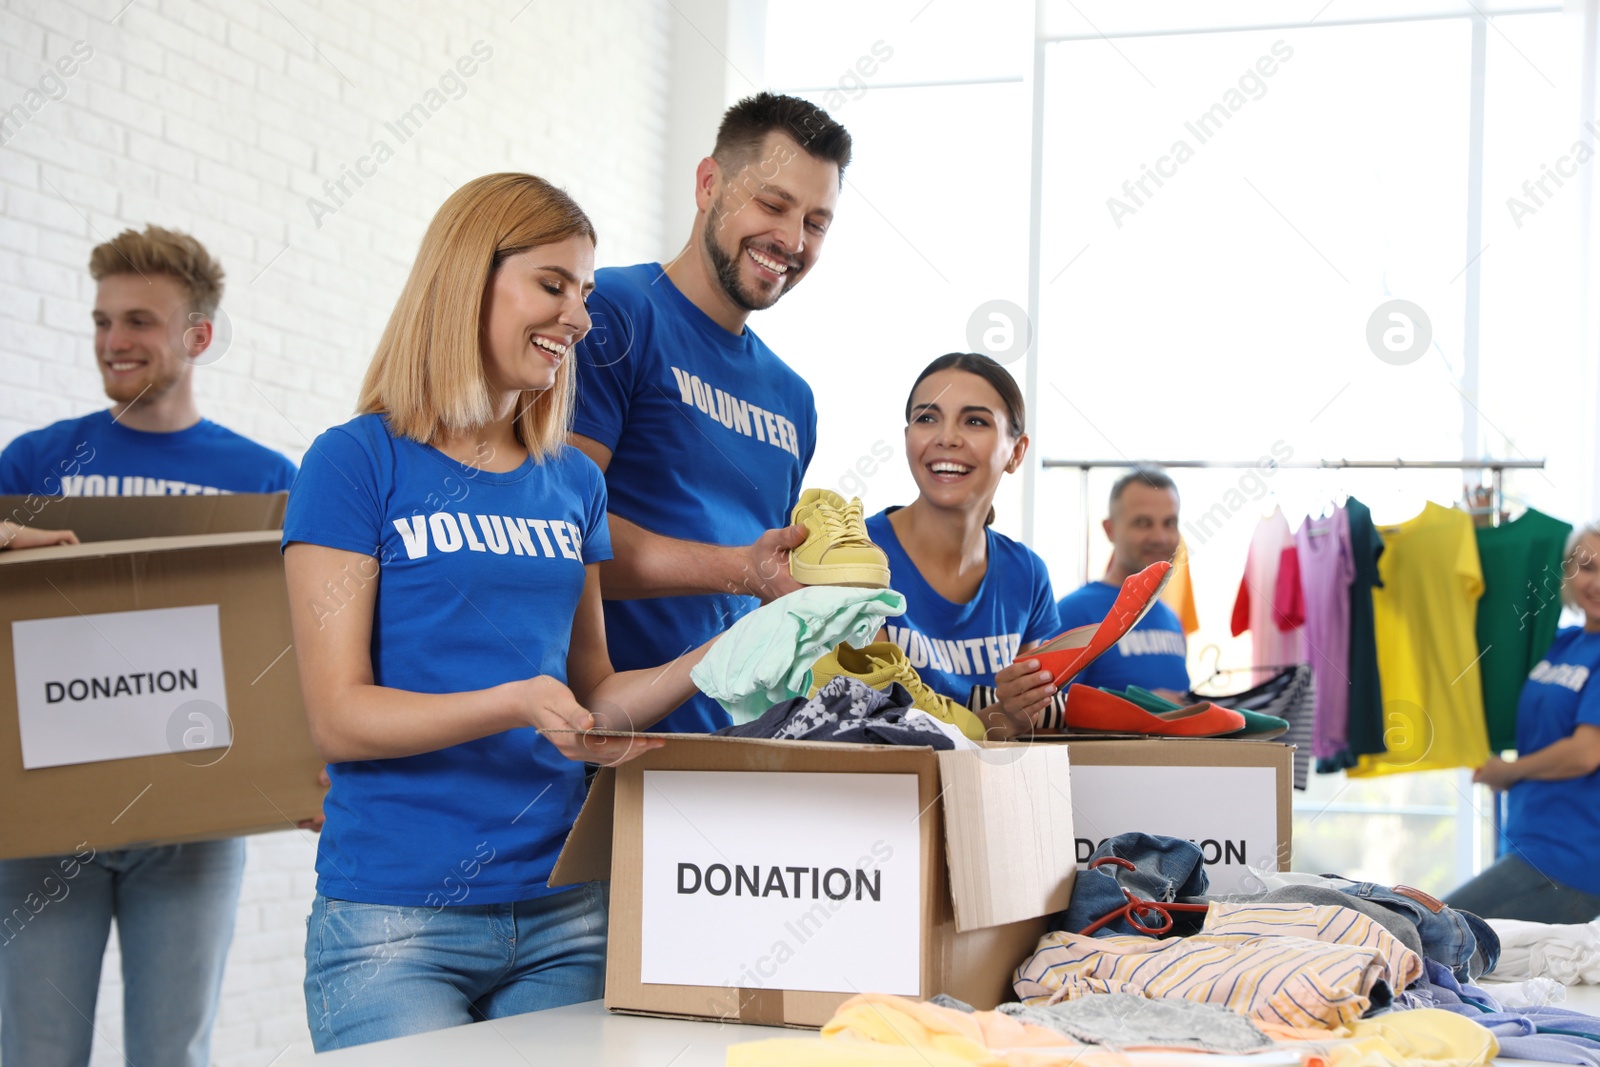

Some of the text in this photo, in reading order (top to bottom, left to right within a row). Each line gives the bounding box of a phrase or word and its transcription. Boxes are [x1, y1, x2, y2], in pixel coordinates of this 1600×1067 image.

[671, 366, 800, 460] VOLUNTEER
[61, 474, 235, 497] VOLUNT
[392, 512, 583, 564] VOLUNTEE
[45, 668, 198, 704] DONATION
[677, 863, 881, 902] DONATION
